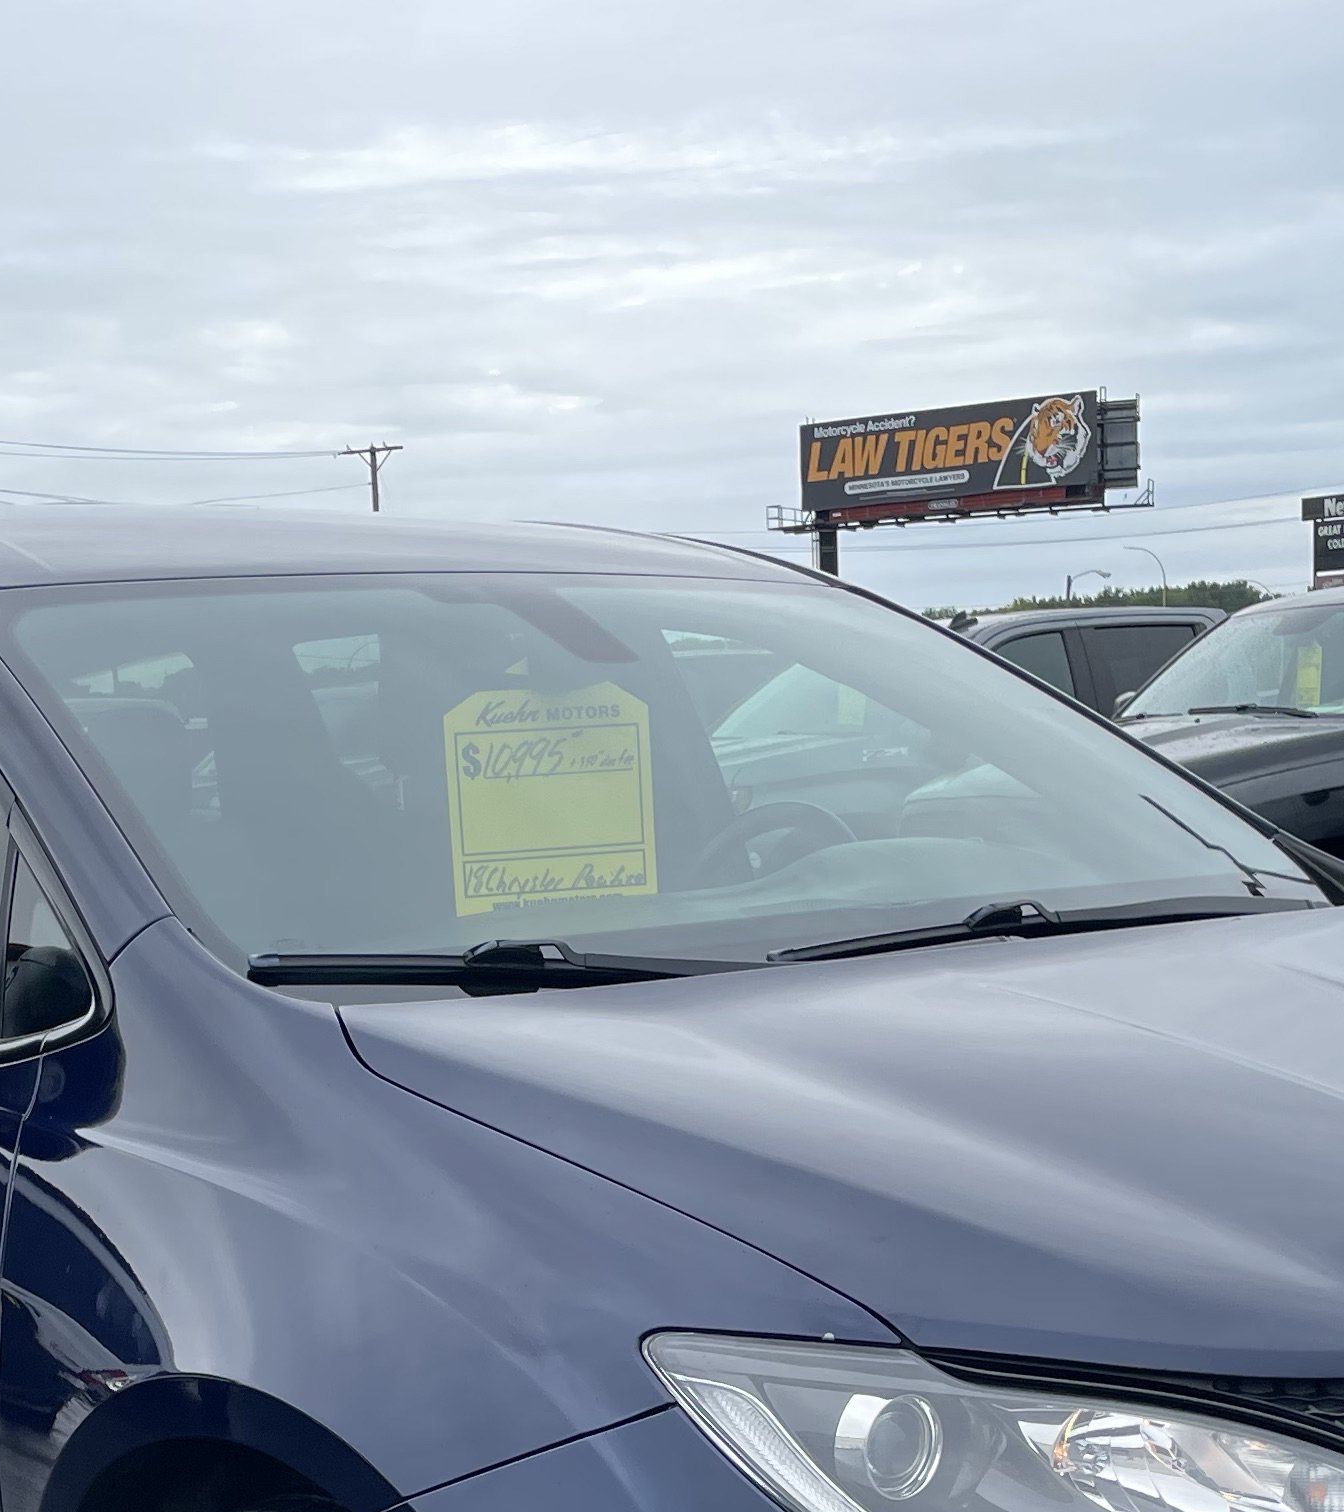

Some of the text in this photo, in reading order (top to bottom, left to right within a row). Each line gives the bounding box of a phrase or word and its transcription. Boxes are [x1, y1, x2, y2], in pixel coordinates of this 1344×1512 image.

[814, 415, 916, 439] Motorcycle Accident?
[807, 417, 1014, 482] LAW TIGERS
[1318, 524, 1342, 537] GREAT
[475, 700, 621, 727] Kuehn MOTORS
